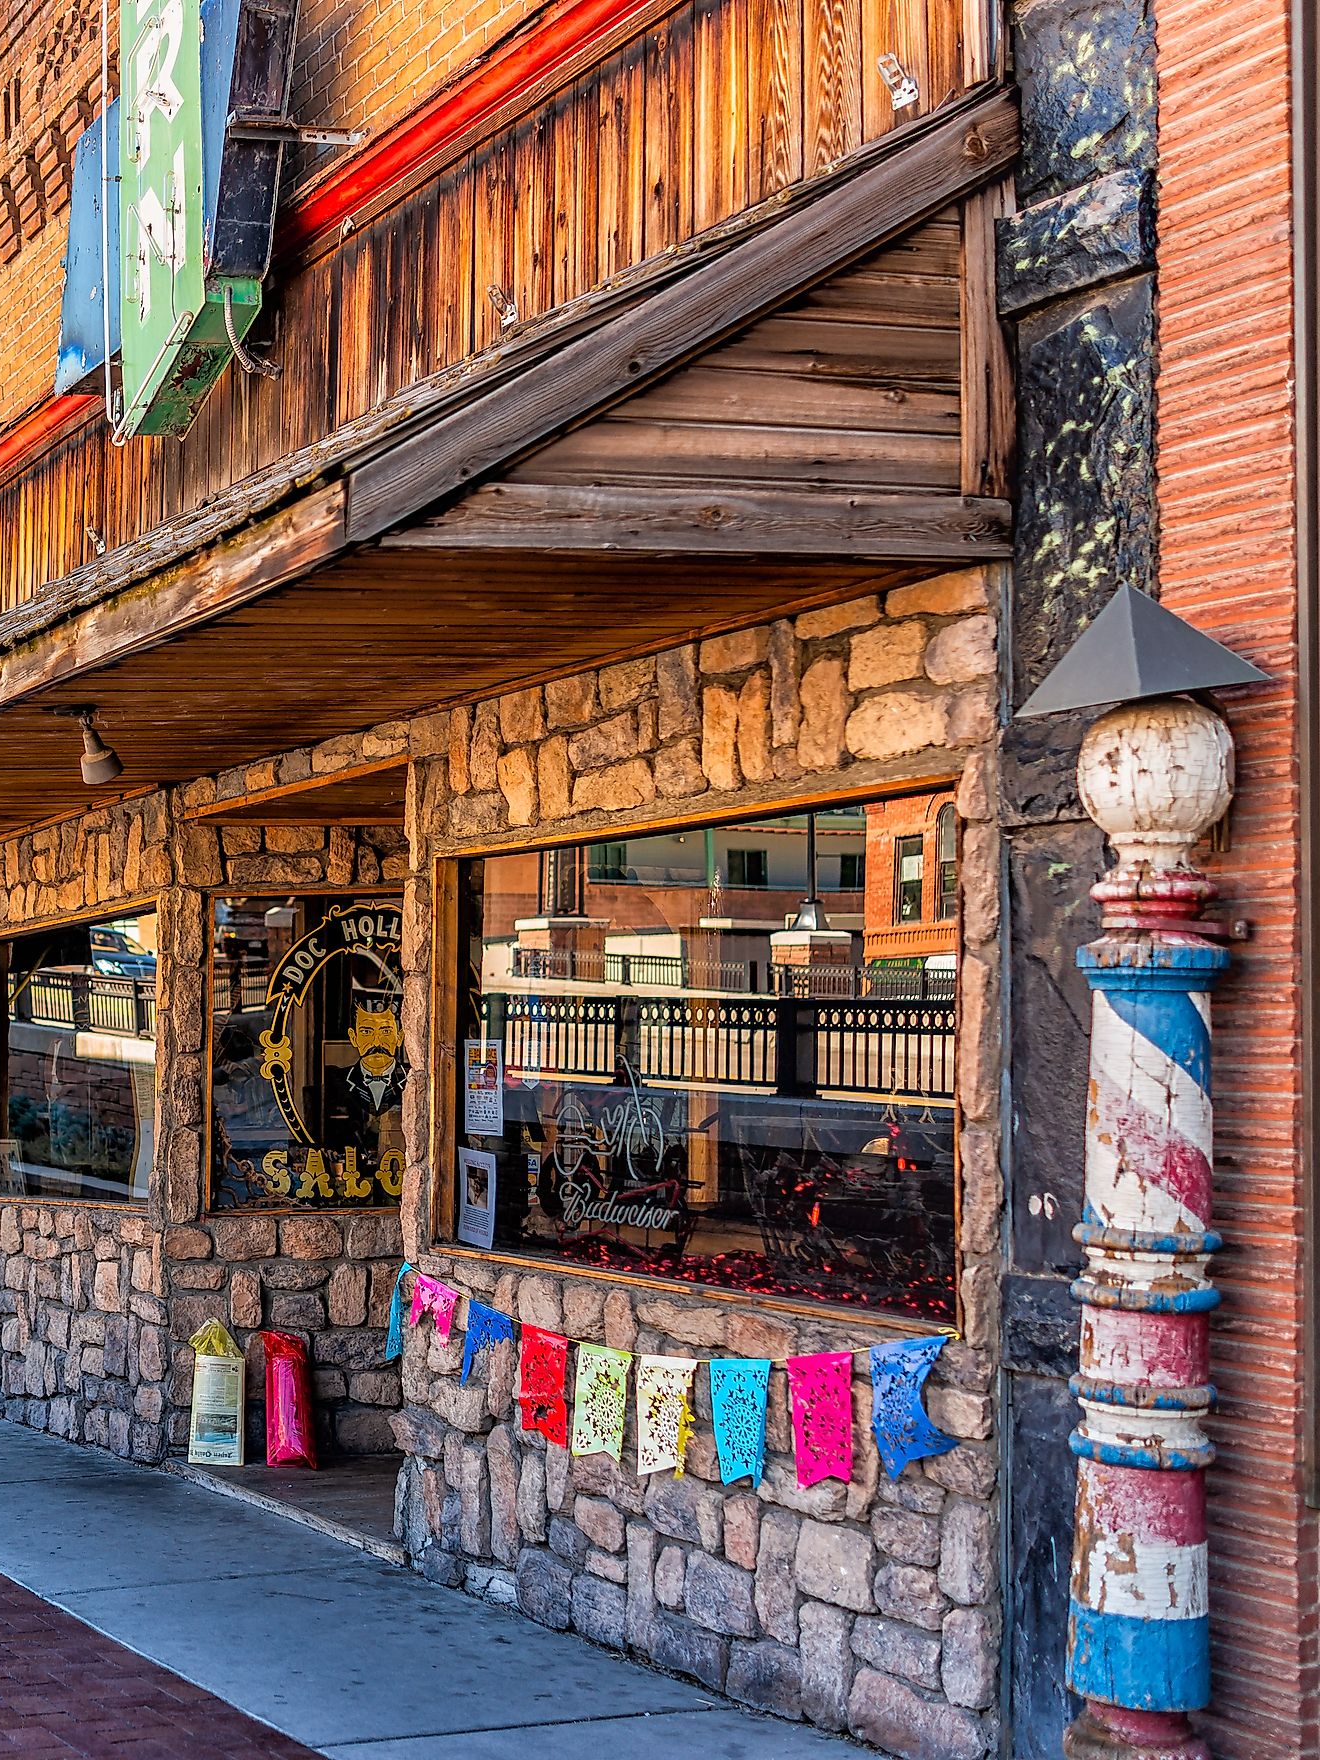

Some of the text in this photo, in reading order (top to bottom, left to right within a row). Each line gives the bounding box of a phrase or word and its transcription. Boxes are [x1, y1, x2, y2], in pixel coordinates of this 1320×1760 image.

[282, 914, 401, 985] DOC HOLL
[261, 1146, 405, 1199] SALO
[559, 1182, 680, 1230] Budweiser
